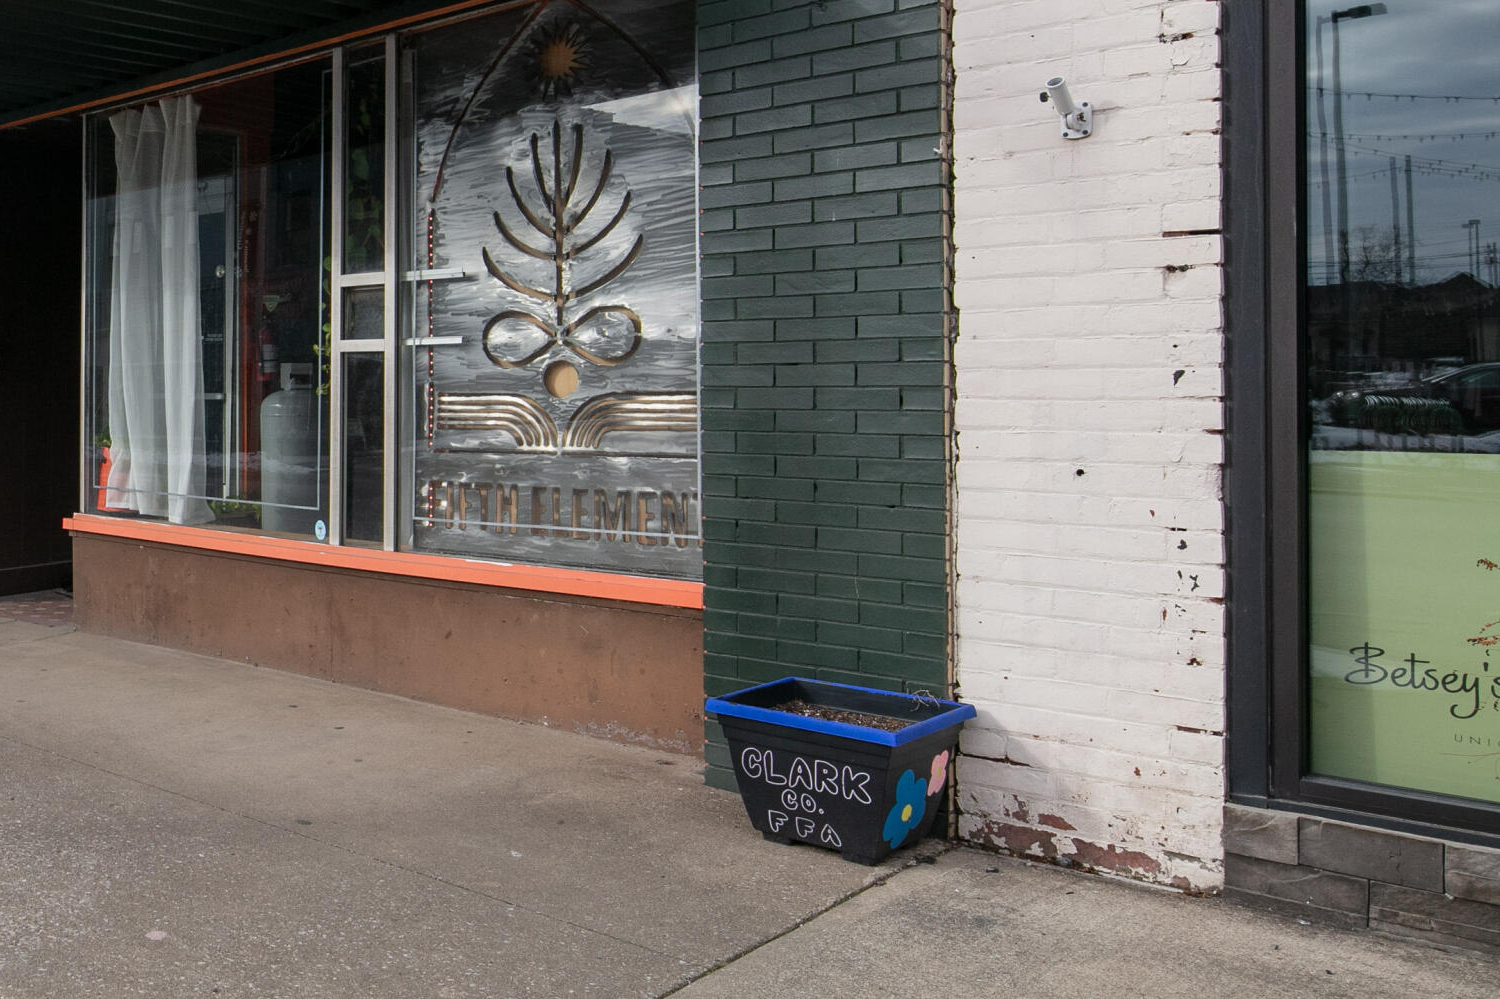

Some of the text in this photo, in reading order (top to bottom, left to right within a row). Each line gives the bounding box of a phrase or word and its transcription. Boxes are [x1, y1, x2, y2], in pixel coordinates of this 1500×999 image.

[427, 480, 703, 550] FIFTH ELEMEN
[1454, 733, 1500, 747] UNI
[741, 747, 872, 805] CLARK
[781, 788, 825, 815] CO.
[768, 809, 842, 848] FFA
